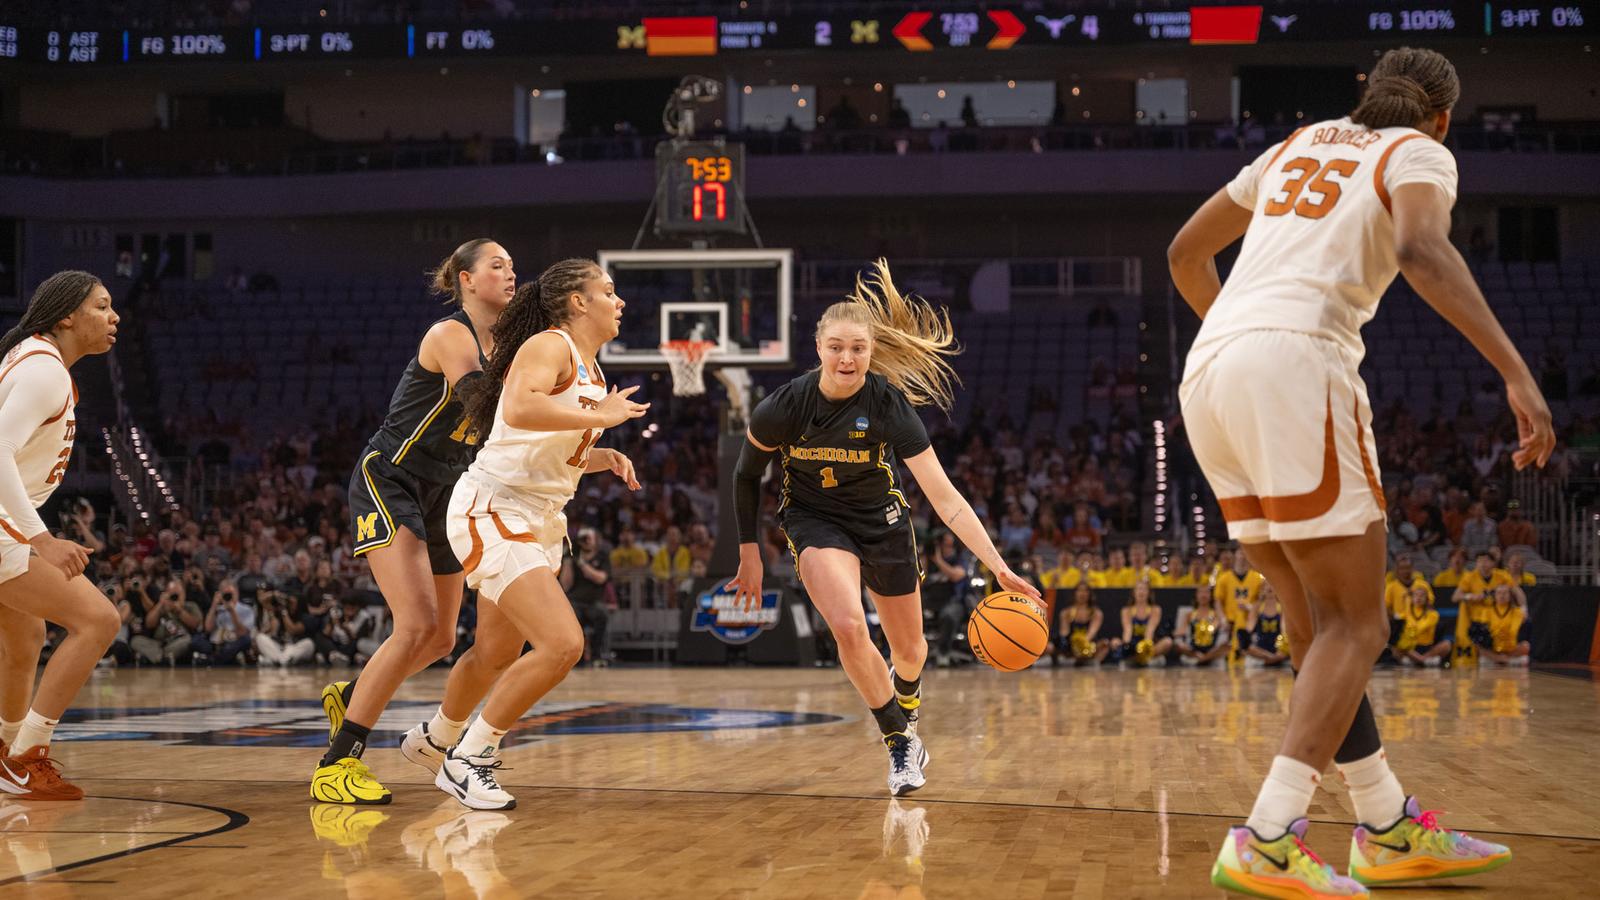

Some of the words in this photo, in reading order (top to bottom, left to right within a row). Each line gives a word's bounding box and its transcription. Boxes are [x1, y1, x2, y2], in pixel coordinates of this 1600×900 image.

[1081, 15, 1098, 39] 4
[1369, 12, 1393, 30] FG
[1400, 10, 1455, 30] 100%
[1500, 9, 1540, 27] 3-PT
[1552, 7, 1583, 26] 0%
[69, 32, 99, 46] AST
[271, 34, 309, 52] 3-PT
[321, 32, 352, 51] 0%
[426, 31, 448, 49] FT
[462, 29, 494, 49] 0%
[815, 21, 832, 46] 2
[69, 47, 98, 61] AST
[142, 37, 164, 54] FG
[171, 35, 225, 54] 100%
[686, 156, 732, 181] 7:53
[1264, 156, 1361, 219] 35
[692, 182, 727, 221] 17
[789, 445, 870, 463] MICHIGAN
[820, 466, 838, 488] 1
[357, 511, 378, 542] M
